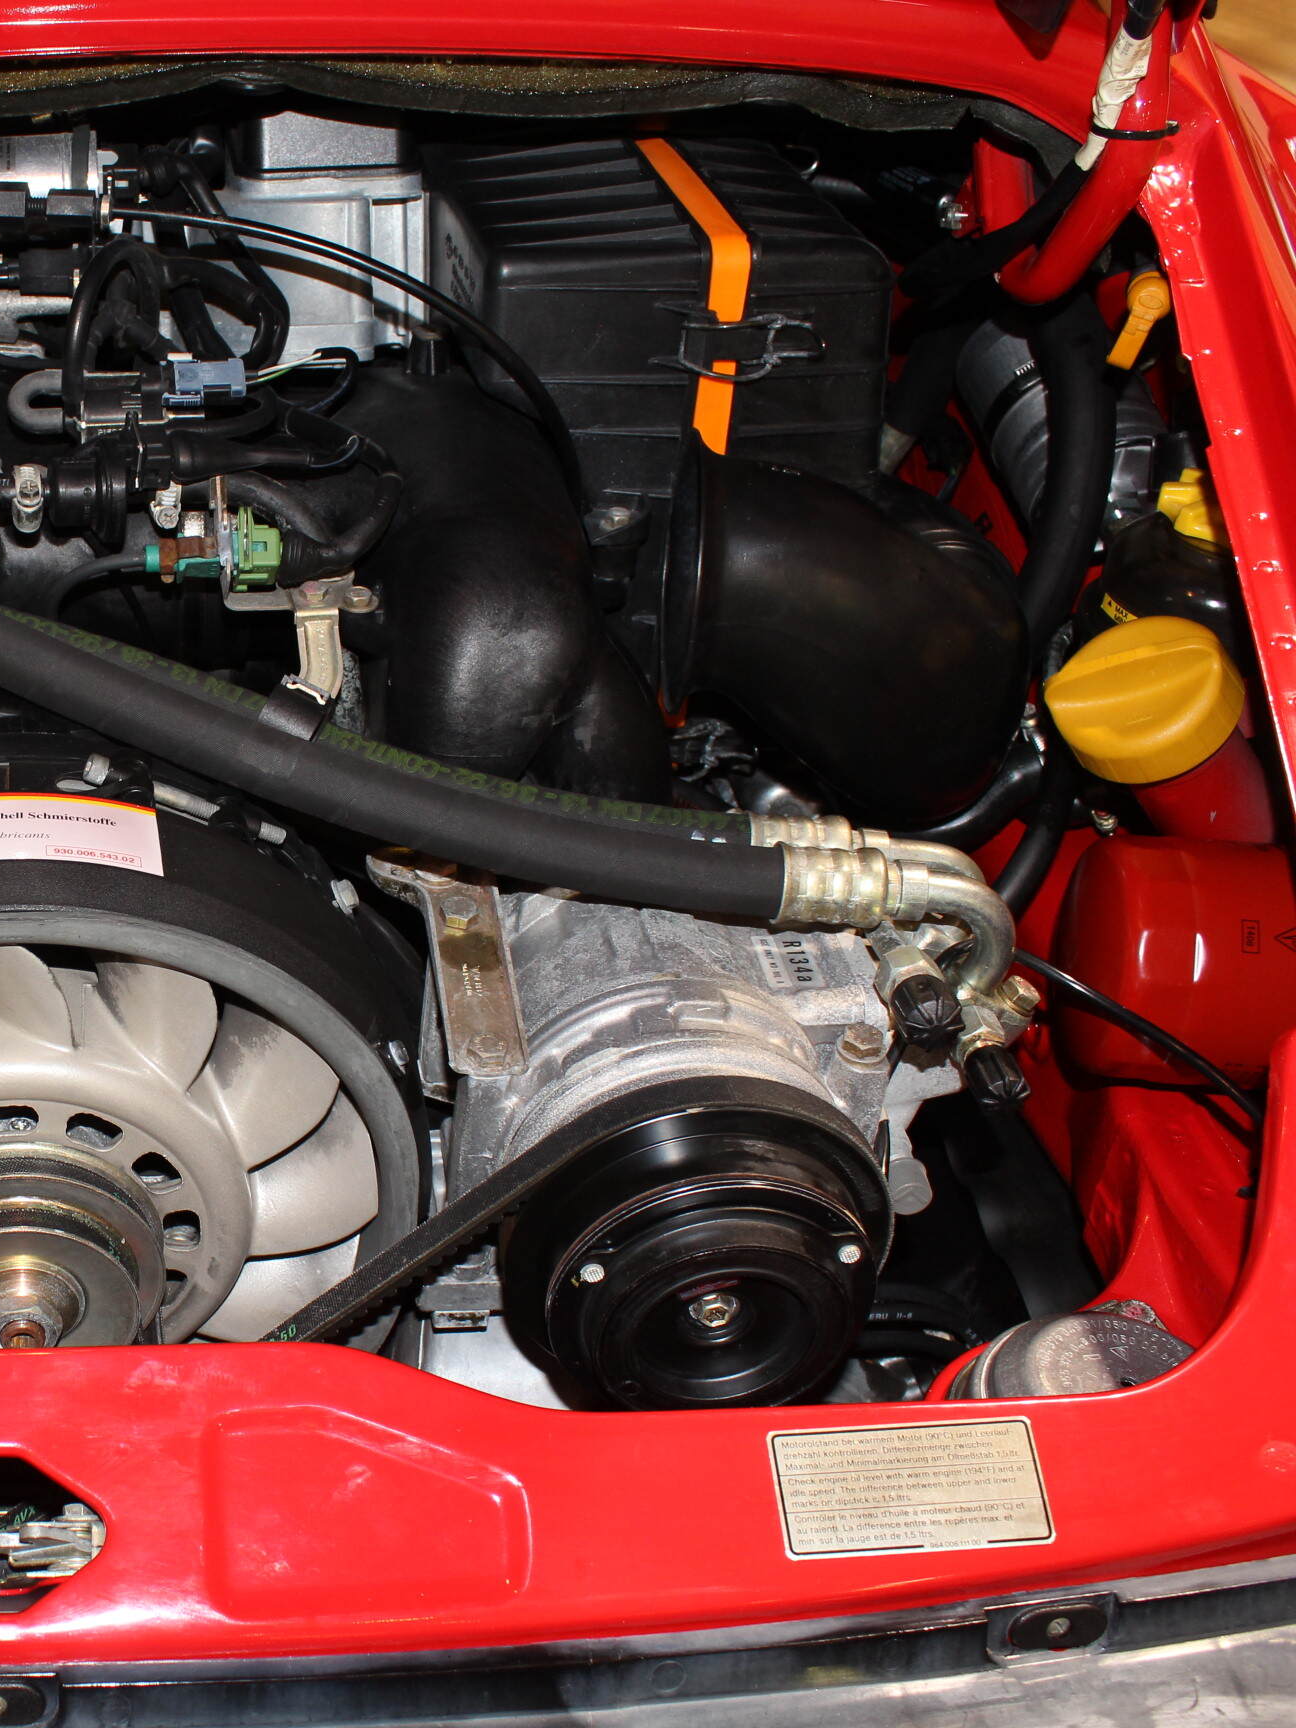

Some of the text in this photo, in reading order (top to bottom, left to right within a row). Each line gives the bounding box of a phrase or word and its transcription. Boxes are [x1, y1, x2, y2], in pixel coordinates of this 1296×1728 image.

[28, 811, 117, 827] Schmierstoffe
[782, 940, 814, 982] R134a
[956, 1431, 973, 1439] und
[788, 1478, 816, 1487] Check
[819, 1475, 849, 1485] engine
[906, 1471, 931, 1479] warm
[932, 1468, 962, 1478] engine
[998, 1465, 1014, 1473] and
[1016, 1464, 1026, 1472] at
[840, 1485, 857, 1494] The
[906, 1480, 944, 1490] between
[946, 1480, 971, 1489] upper
[974, 1478, 991, 1486] and
[954, 1504, 983, 1513] chaud
[1015, 1502, 1026, 1510] et
[843, 1523, 854, 1532] La
[904, 1519, 927, 1528] entre
[929, 1518, 943, 1526] les
[846, 1534, 871, 1545] jauge
[873, 1533, 888, 1541] est
[890, 1532, 902, 1540] de
